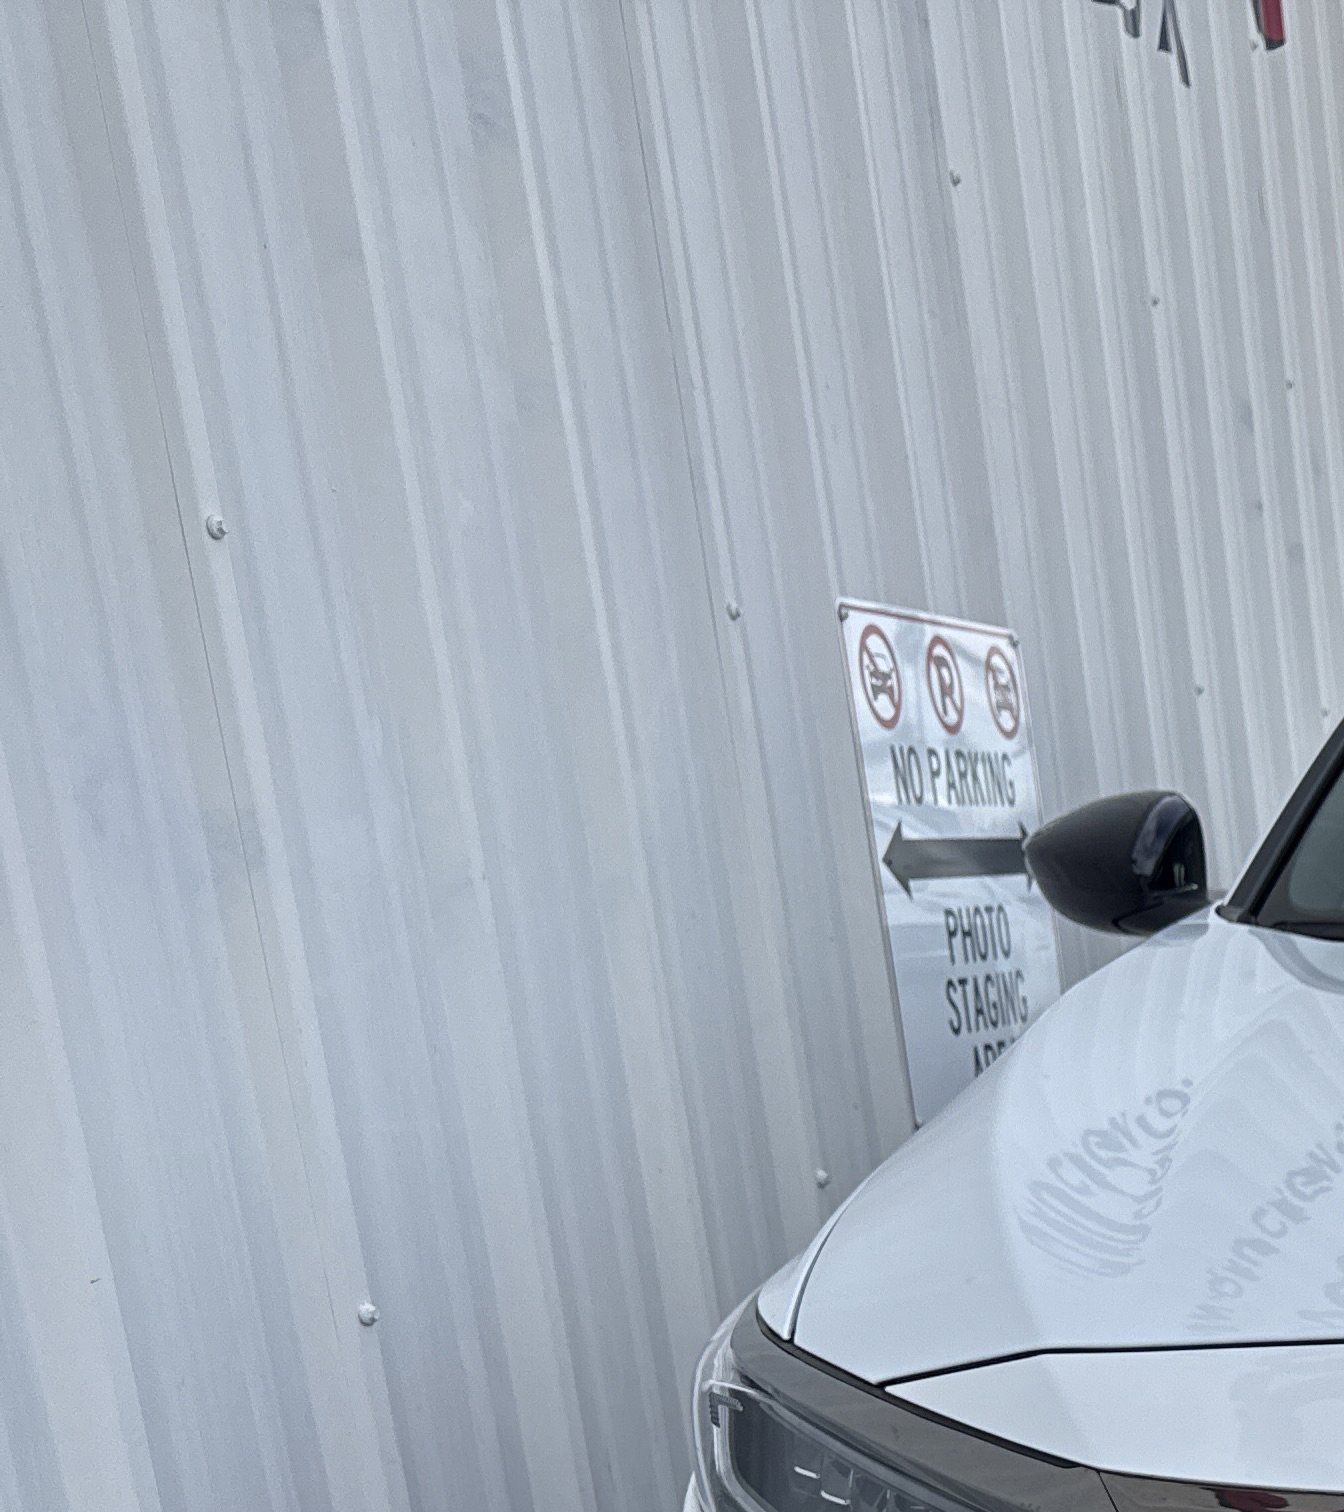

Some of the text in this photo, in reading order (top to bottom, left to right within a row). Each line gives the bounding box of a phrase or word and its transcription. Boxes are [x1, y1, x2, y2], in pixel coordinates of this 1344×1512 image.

[890, 745, 1016, 807] NO PARKING
[944, 903, 1011, 966] PHOTO
[946, 968, 1028, 1037] STAGING
[973, 1038, 1016, 1077] AR
